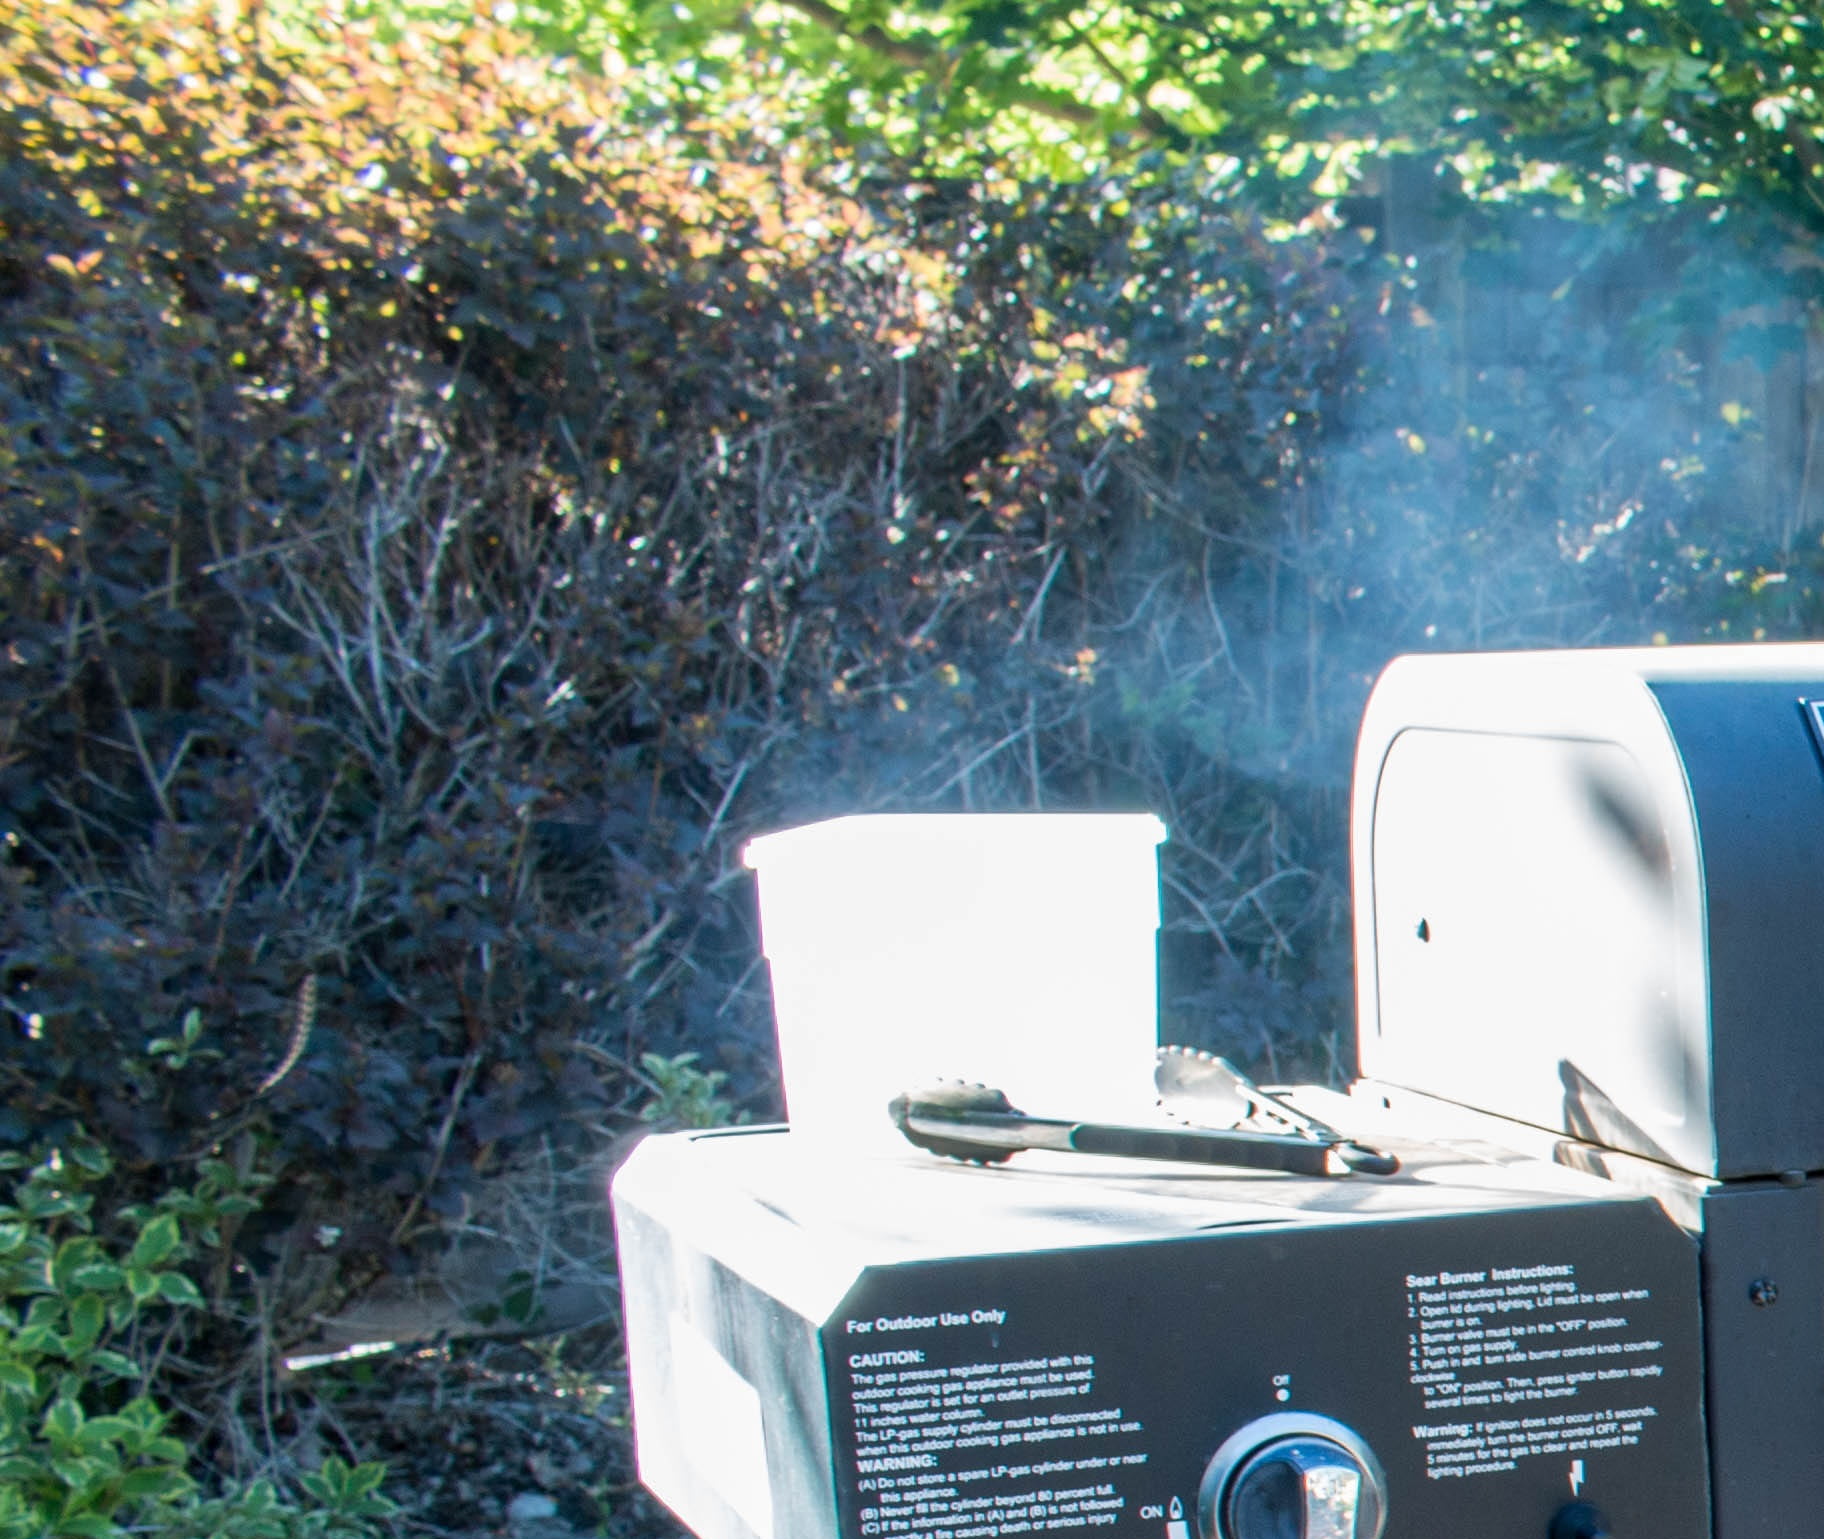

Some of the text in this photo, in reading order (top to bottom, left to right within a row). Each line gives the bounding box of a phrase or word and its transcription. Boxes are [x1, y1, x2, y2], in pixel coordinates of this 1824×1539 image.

[1405, 1262, 1572, 1287] Sear Burner Instructions:
[845, 1308, 1004, 1333] For Outdoor Use Only
[848, 1349, 923, 1368] CAUTION:
[1273, 1374, 1290, 1385] Off
[856, 1453, 936, 1473] WARNING:
[1139, 1505, 1162, 1519] ON
